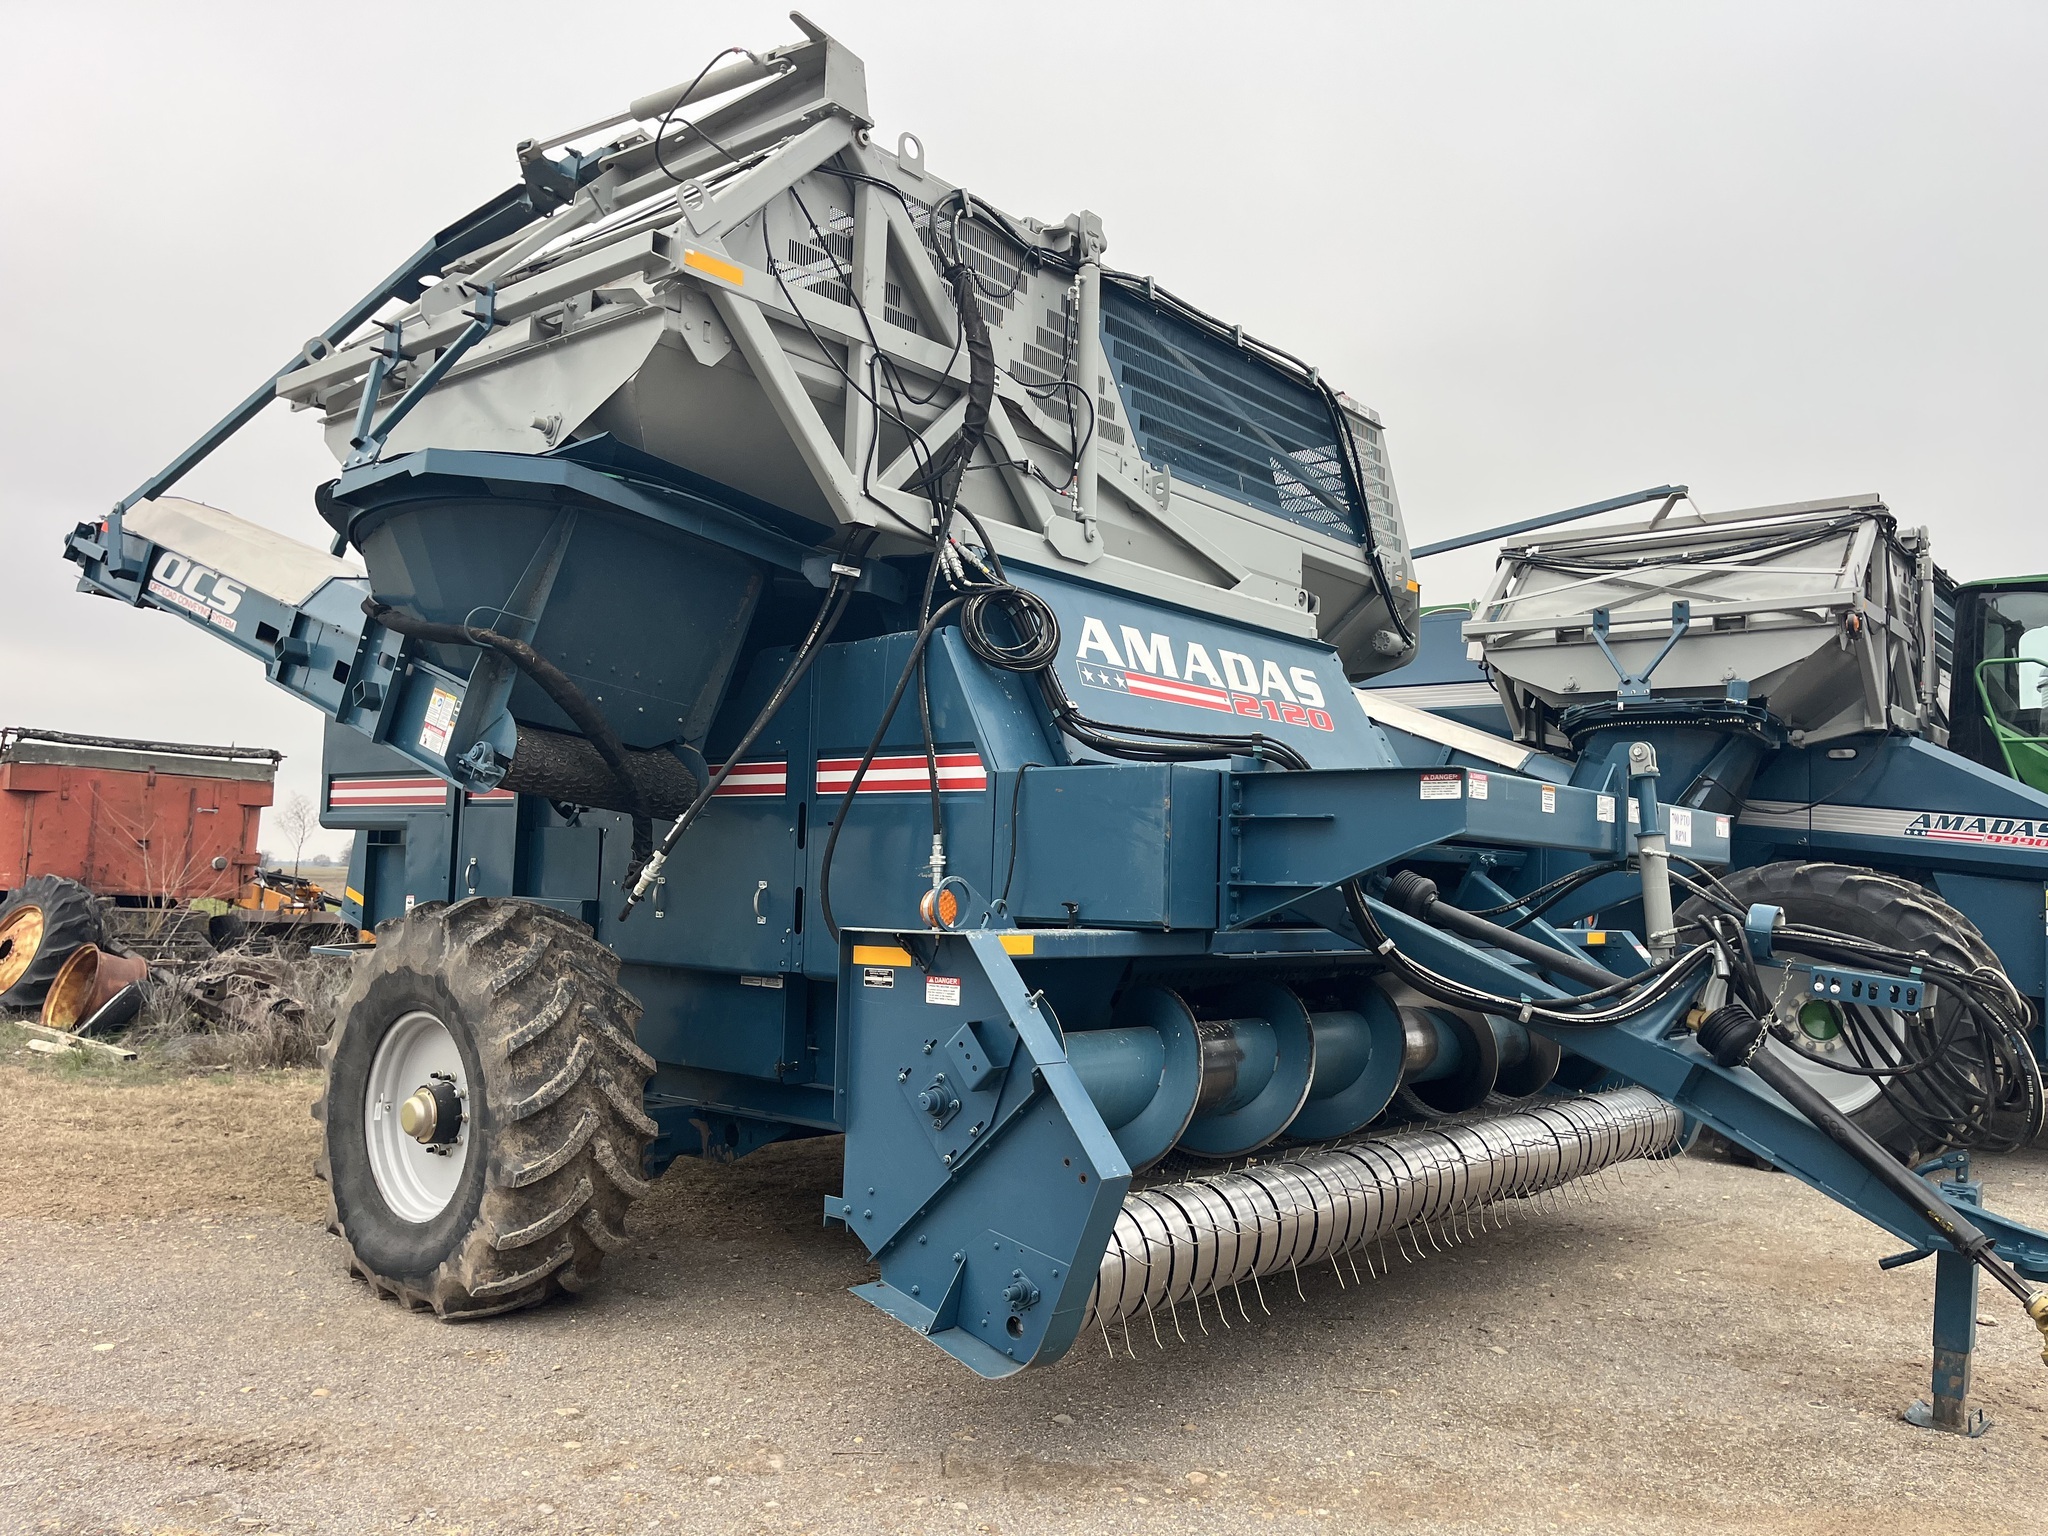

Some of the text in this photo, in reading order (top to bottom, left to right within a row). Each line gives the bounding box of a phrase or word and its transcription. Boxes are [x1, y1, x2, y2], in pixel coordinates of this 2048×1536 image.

[152, 551, 247, 615] OCS
[178, 594, 210, 617] CONVEYING
[211, 612, 235, 631] SYSTEM
[1076, 616, 1325, 708] AMADAS
[1231, 692, 1335, 732] 2120
[1430, 773, 1459, 781] DANGER
[934, 976, 958, 985] DANGER
